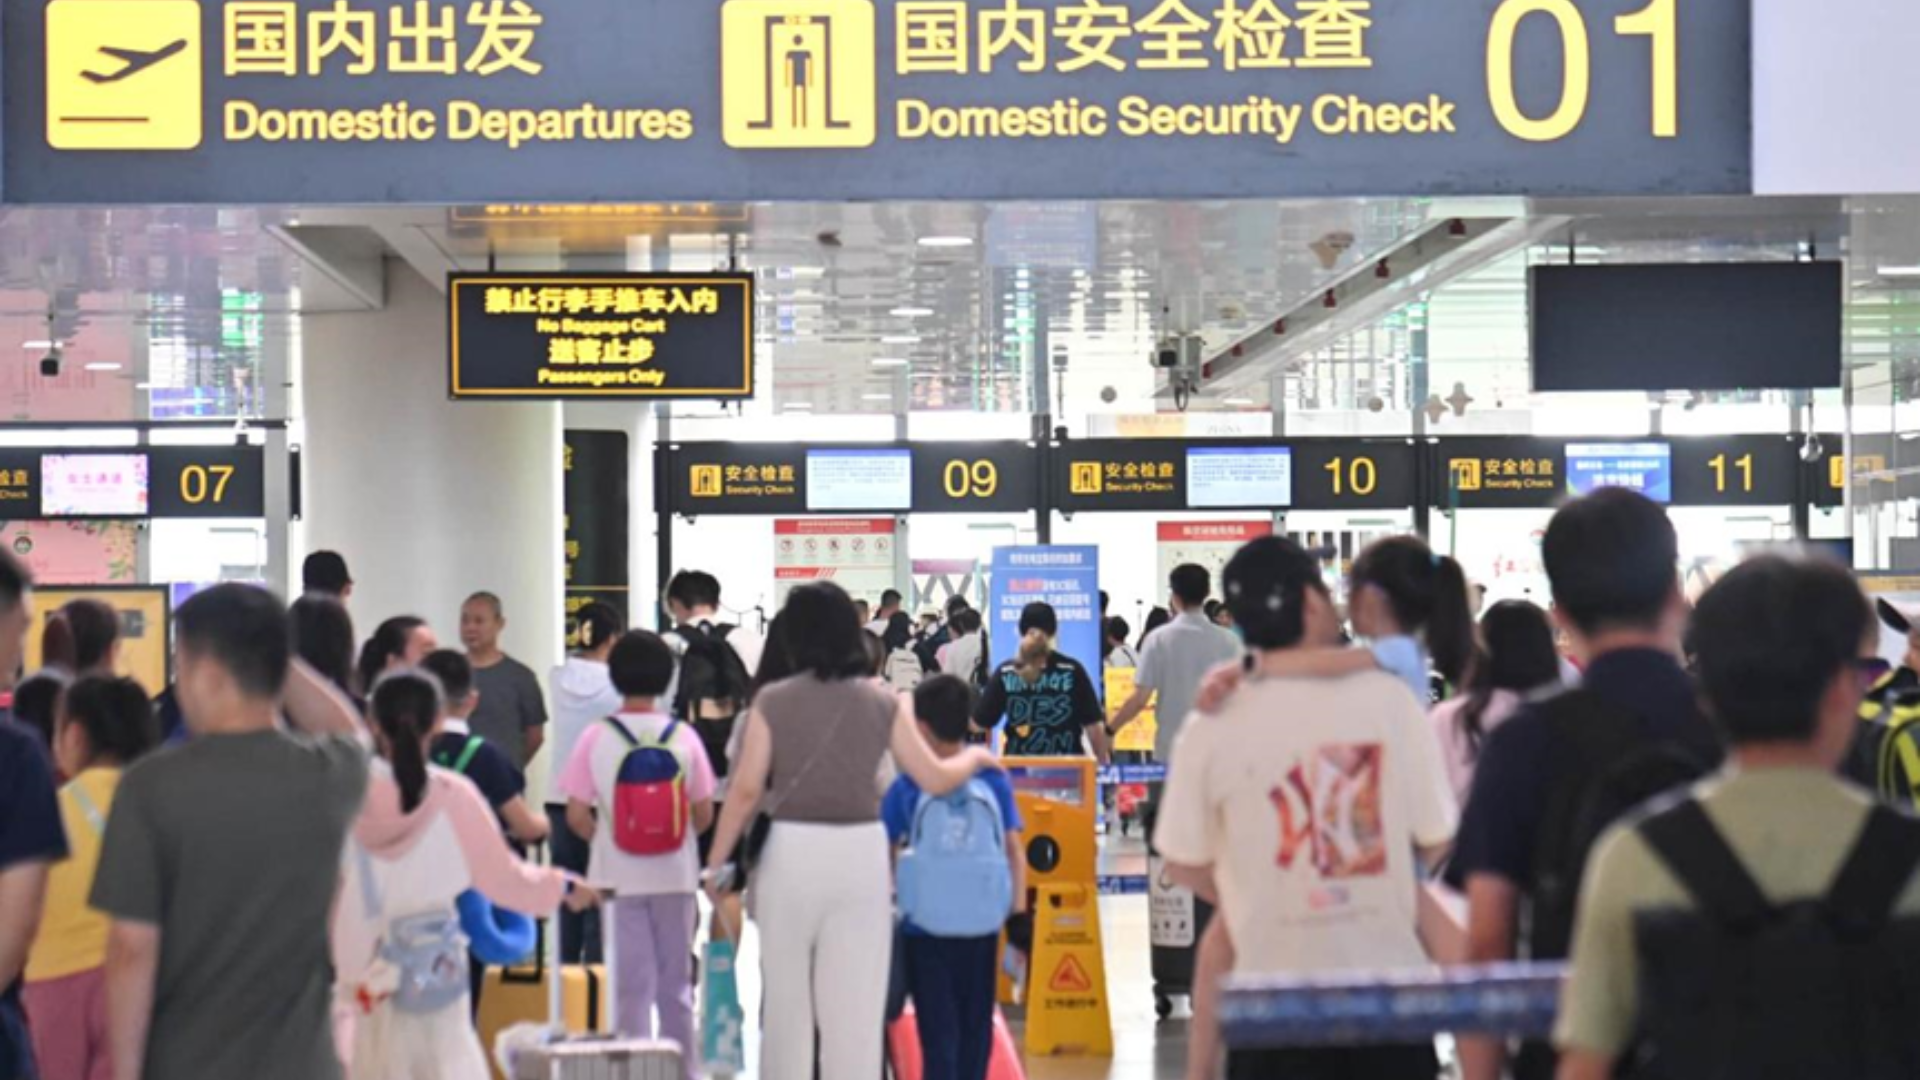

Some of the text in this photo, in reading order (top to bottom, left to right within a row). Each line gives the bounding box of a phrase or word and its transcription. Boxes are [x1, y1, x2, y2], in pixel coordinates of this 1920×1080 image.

[223, 0, 543, 76] 国内出发
[895, 0, 1372, 75] 国内安全检查
[1486, 0, 1677, 141] 01
[224, 100, 693, 148] Domestic Departures
[896, 94, 1456, 144] Domestic Security Check
[485, 287, 718, 313] 禁止行李手推车入内
[537, 319, 666, 335] No Baggage Cart
[548, 337, 654, 364] 送客止步
[538, 369, 665, 386] Passengers Only
[725, 465, 795, 482] 安全检查
[944, 459, 997, 498] 09
[1105, 462, 1174, 478] 安全检查
[1325, 457, 1376, 494] 10
[1485, 459, 1553, 475] 安全检查
[1708, 454, 1752, 491] 11
[180, 465, 234, 503] 07
[725, 485, 795, 496] Security Check
[1105, 482, 1174, 492] Security Check
[1485, 478, 1553, 489] Security Check
